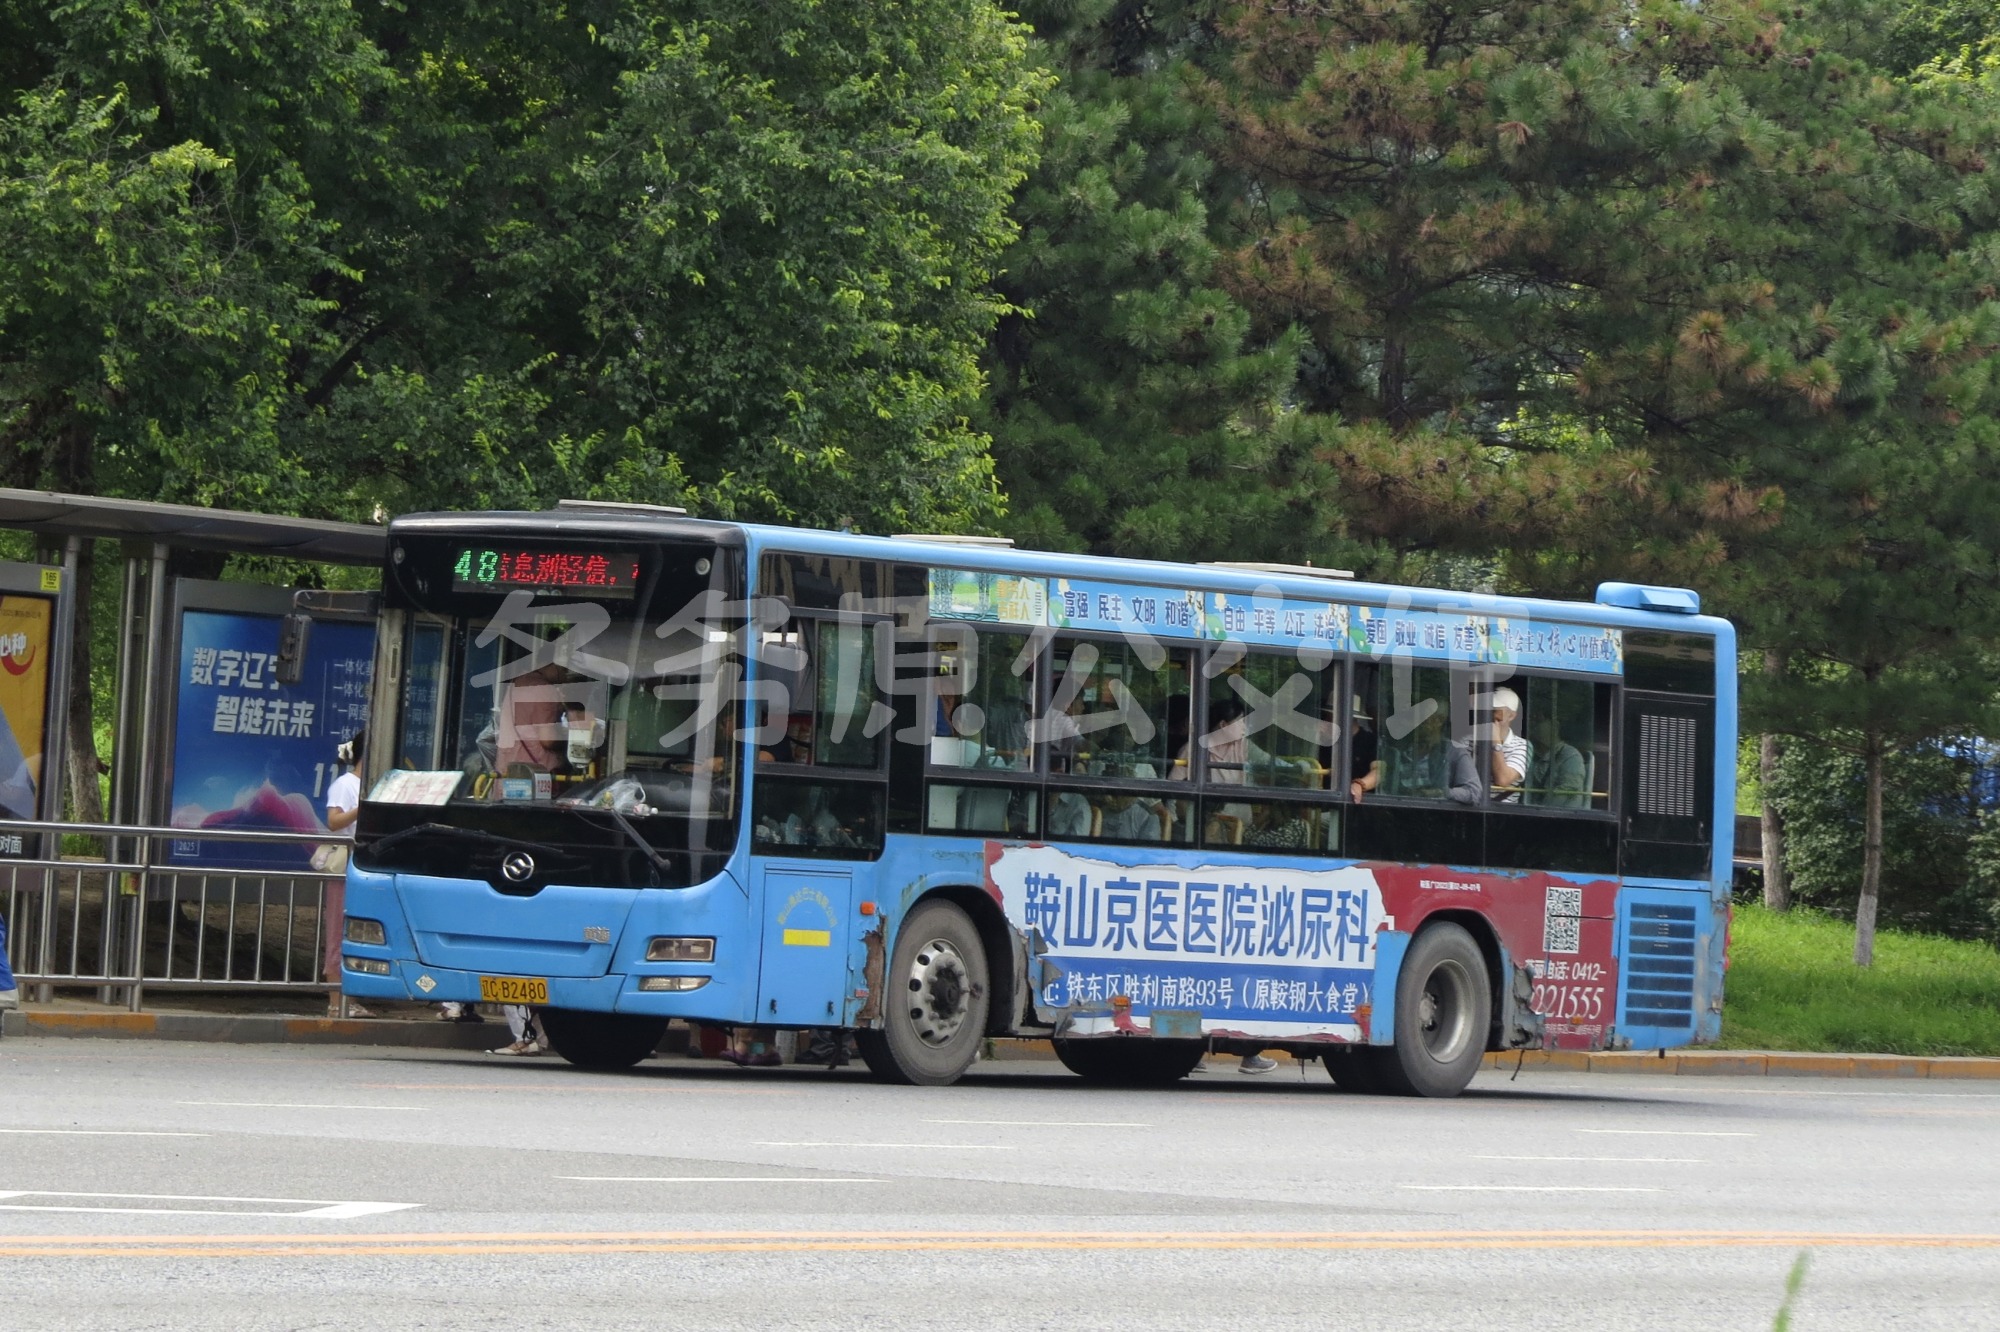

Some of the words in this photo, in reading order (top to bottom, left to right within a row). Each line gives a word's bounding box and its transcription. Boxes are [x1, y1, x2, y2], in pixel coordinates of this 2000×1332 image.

[454, 550, 498, 582] 48
[1064, 590, 1089, 619] 富强
[1098, 594, 1122, 622] 民主
[1132, 597, 1156, 624] 文明
[1165, 600, 1189, 627] 和谐
[1224, 604, 1246, 633] 自由
[1254, 607, 1276, 635] 平等
[1284, 610, 1306, 638] 公正
[1313, 612, 1336, 640] 法治
[1365, 618, 1388, 645] 爱国
[1395, 620, 1417, 647] 敬业
[1424, 623, 1445, 649] 诚信
[1453, 624, 1475, 651] 友善
[213, 694, 315, 739] 智链未来
[1024, 871, 1369, 963] 鞍山京医医院泌尿科
